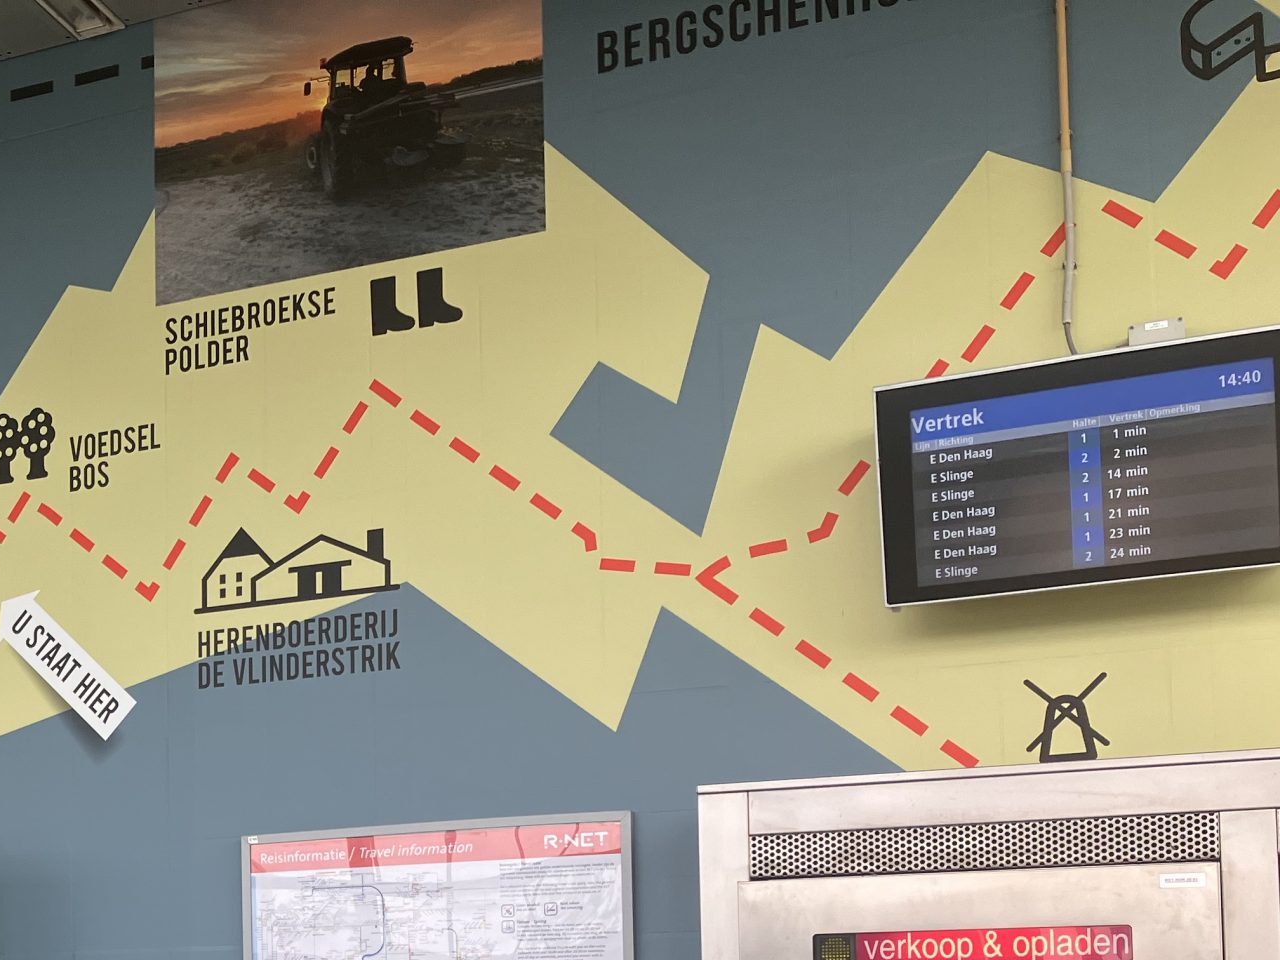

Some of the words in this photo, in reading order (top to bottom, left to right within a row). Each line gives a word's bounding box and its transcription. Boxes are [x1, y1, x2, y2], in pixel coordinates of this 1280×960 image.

[597, 0, 910, 74] BERGSCHEN
[165, 287, 336, 345] SCHIEBROEKSE
[165, 335, 249, 375] POLDER
[911, 407, 984, 434] Vertrek
[1218, 370, 1261, 388] 14:40
[69, 423, 161, 462] VOEDSEL
[930, 454, 936, 465] E
[939, 451, 961, 463] Den
[964, 447, 993, 460] Haag
[1081, 433, 1087, 443] 1
[1113, 429, 1119, 439] 1
[1124, 425, 1147, 437] min
[938, 436, 974, 448] Richting
[1073, 418, 1096, 428] Halte
[1109, 411, 1143, 423] Vertrek
[1149, 403, 1201, 418] Opmerking
[69, 462, 110, 492] BOS
[930, 473, 937, 484] E
[940, 469, 974, 483] Slinge
[1081, 453, 1088, 463] 2
[1113, 448, 1120, 459] 2
[1125, 445, 1148, 457] min
[931, 493, 938, 503] E
[941, 488, 975, 502] Slinge
[1082, 472, 1089, 483] 2
[1107, 468, 1121, 480] 14
[1126, 465, 1148, 477] min
[932, 512, 939, 522] E
[941, 508, 963, 521] Den
[966, 505, 996, 519] Haag
[1083, 492, 1089, 502] 1
[1108, 488, 1122, 499] 17
[1126, 485, 1149, 497] min
[933, 531, 940, 541] E
[942, 527, 964, 540] Den
[967, 524, 997, 538] Haag
[1084, 512, 1090, 522] 1
[1108, 508, 1122, 519] 21
[1127, 505, 1150, 517] min
[934, 550, 941, 560] E
[943, 546, 965, 559] Den
[968, 543, 997, 557] Haag
[1084, 531, 1091, 542] 1
[1109, 528, 1123, 539] 23
[1128, 525, 1151, 537] min
[935, 568, 942, 579] E
[944, 565, 978, 579] Slinge
[1085, 551, 1092, 562] 2
[1110, 548, 1124, 560] 24
[1129, 545, 1151, 557] min
[198, 608, 398, 658] HERENBOERDERIJ
[12, 609, 33, 635] U
[25, 625, 82, 683] STAAT
[72, 672, 119, 724] HIER
[198, 660, 224, 689] DE
[233, 641, 401, 686] VLINDERSTRIK
[260, 848, 346, 865] Reisinformatie
[348, 847, 355, 861] /
[359, 844, 396, 859] Travel
[397, 841, 473, 857] information
[983, 930, 1003, 958] &
